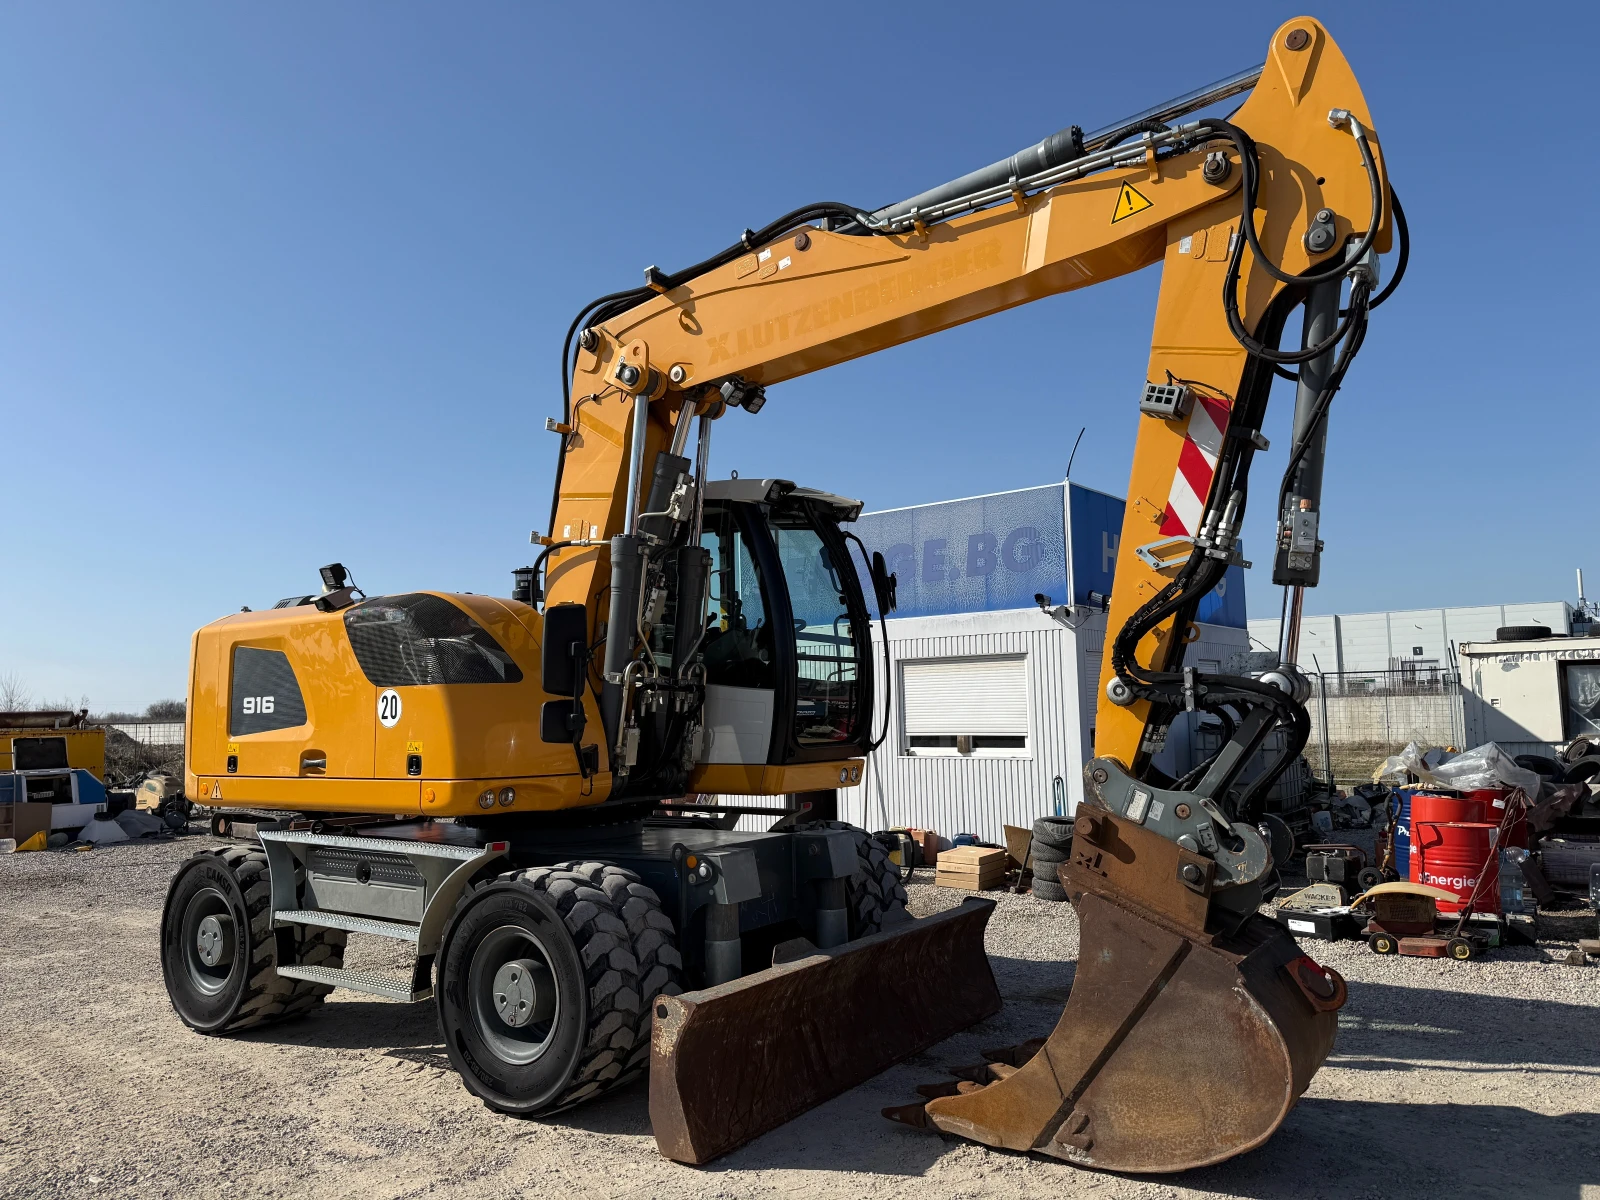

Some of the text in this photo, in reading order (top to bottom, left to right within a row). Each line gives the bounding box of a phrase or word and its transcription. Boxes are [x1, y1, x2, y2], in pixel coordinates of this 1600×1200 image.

[243, 696, 275, 714] 916
[381, 695, 398, 720] 20
[206, 866, 232, 896] CAMSO
[1304, 893, 1337, 901] WACKER
